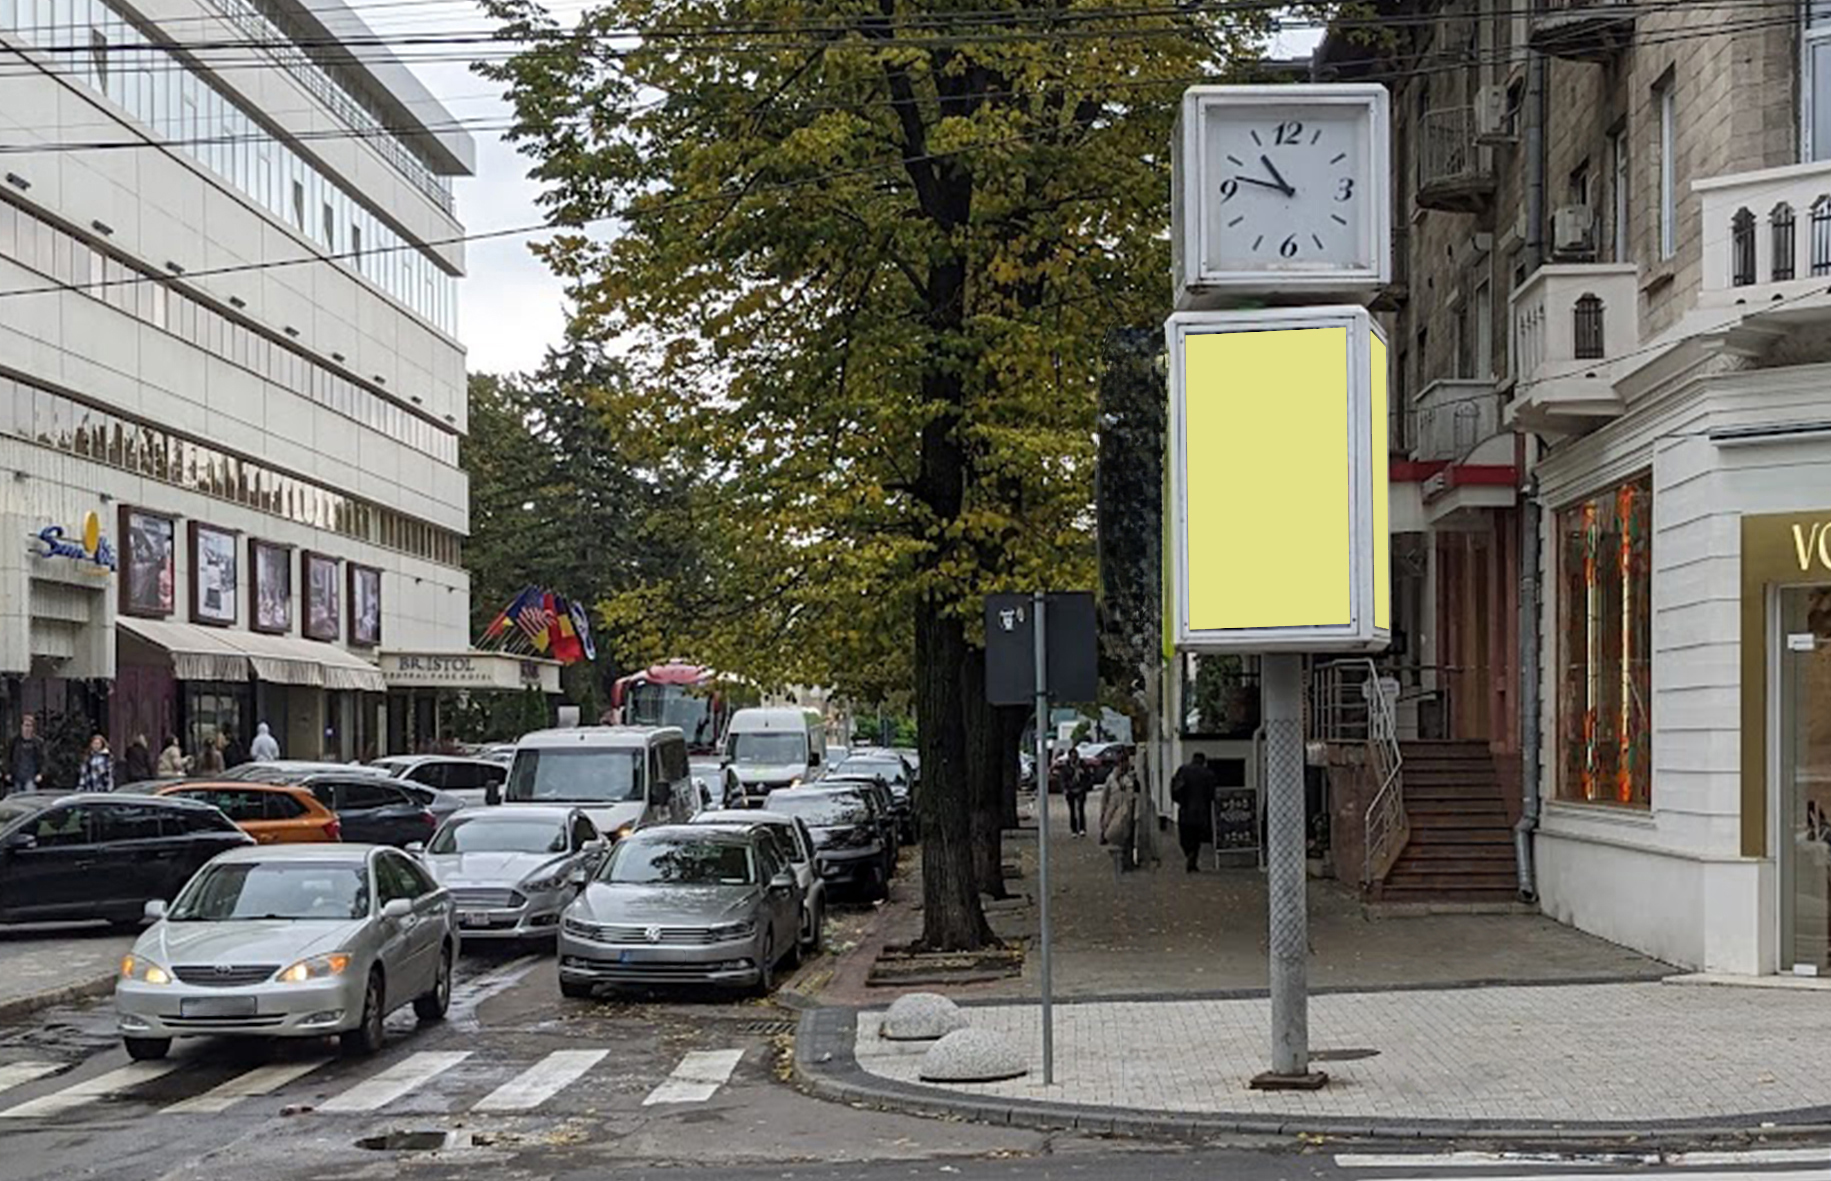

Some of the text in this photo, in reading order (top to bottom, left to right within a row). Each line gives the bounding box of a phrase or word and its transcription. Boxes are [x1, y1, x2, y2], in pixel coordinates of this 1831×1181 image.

[1272, 121, 1303, 146] 12
[1219, 179, 1238, 205] 9
[1333, 177, 1354, 202] 3
[1279, 233, 1298, 258] 6
[399, 656, 475, 672] BRISTOL
